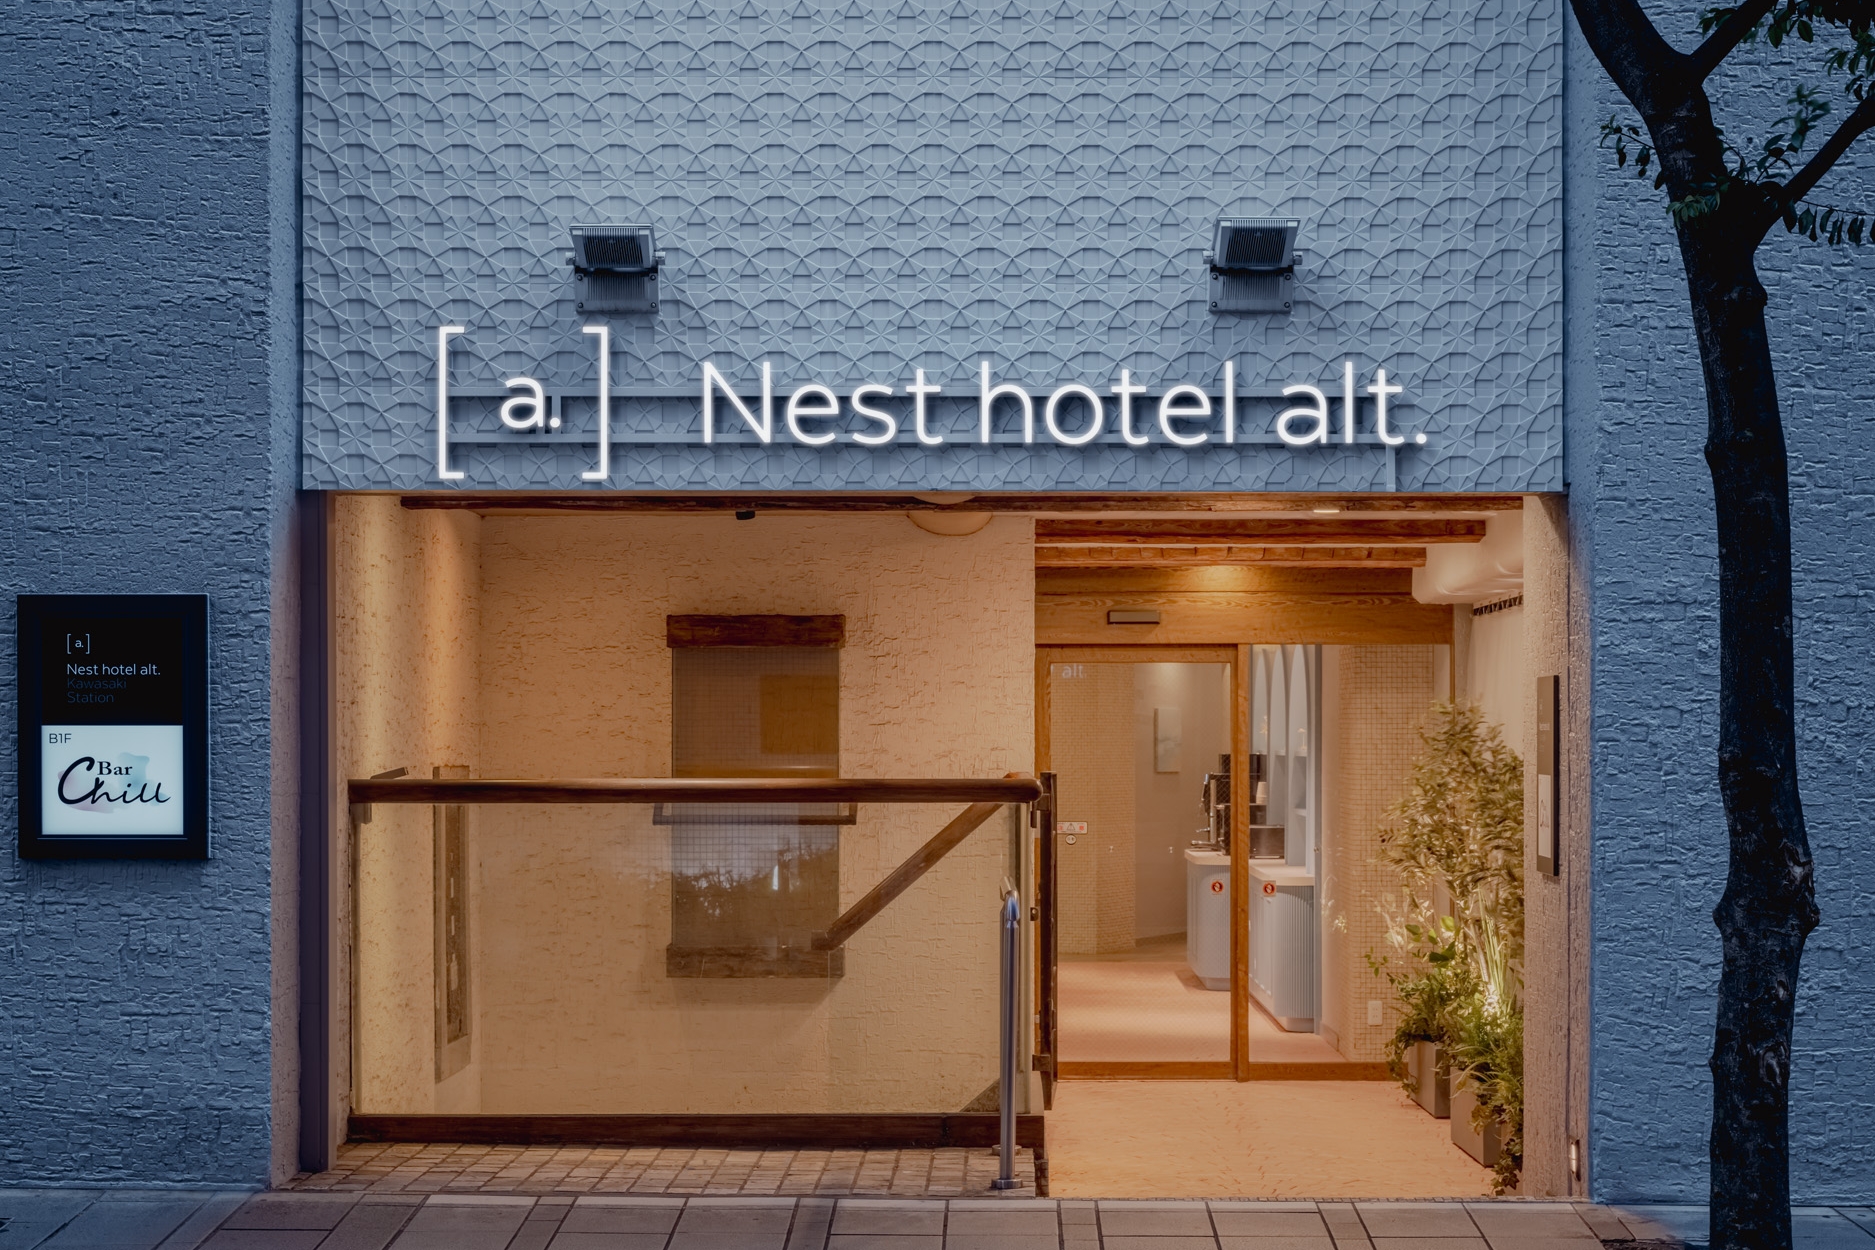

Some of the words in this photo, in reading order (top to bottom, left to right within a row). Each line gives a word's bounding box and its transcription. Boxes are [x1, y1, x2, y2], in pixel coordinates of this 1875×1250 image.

[700, 359, 943, 447] Nest
[980, 358, 1238, 447] hotel
[1274, 358, 1430, 447] alt.
[66, 663, 99, 676] Nest
[102, 663, 137, 676] hotel
[140, 663, 161, 676] alt.
[66, 677, 127, 690] Kawasaki
[66, 691, 114, 704] Station
[48, 733, 72, 744] B1F
[97, 760, 133, 776] Bar
[57, 756, 171, 805] Chill
